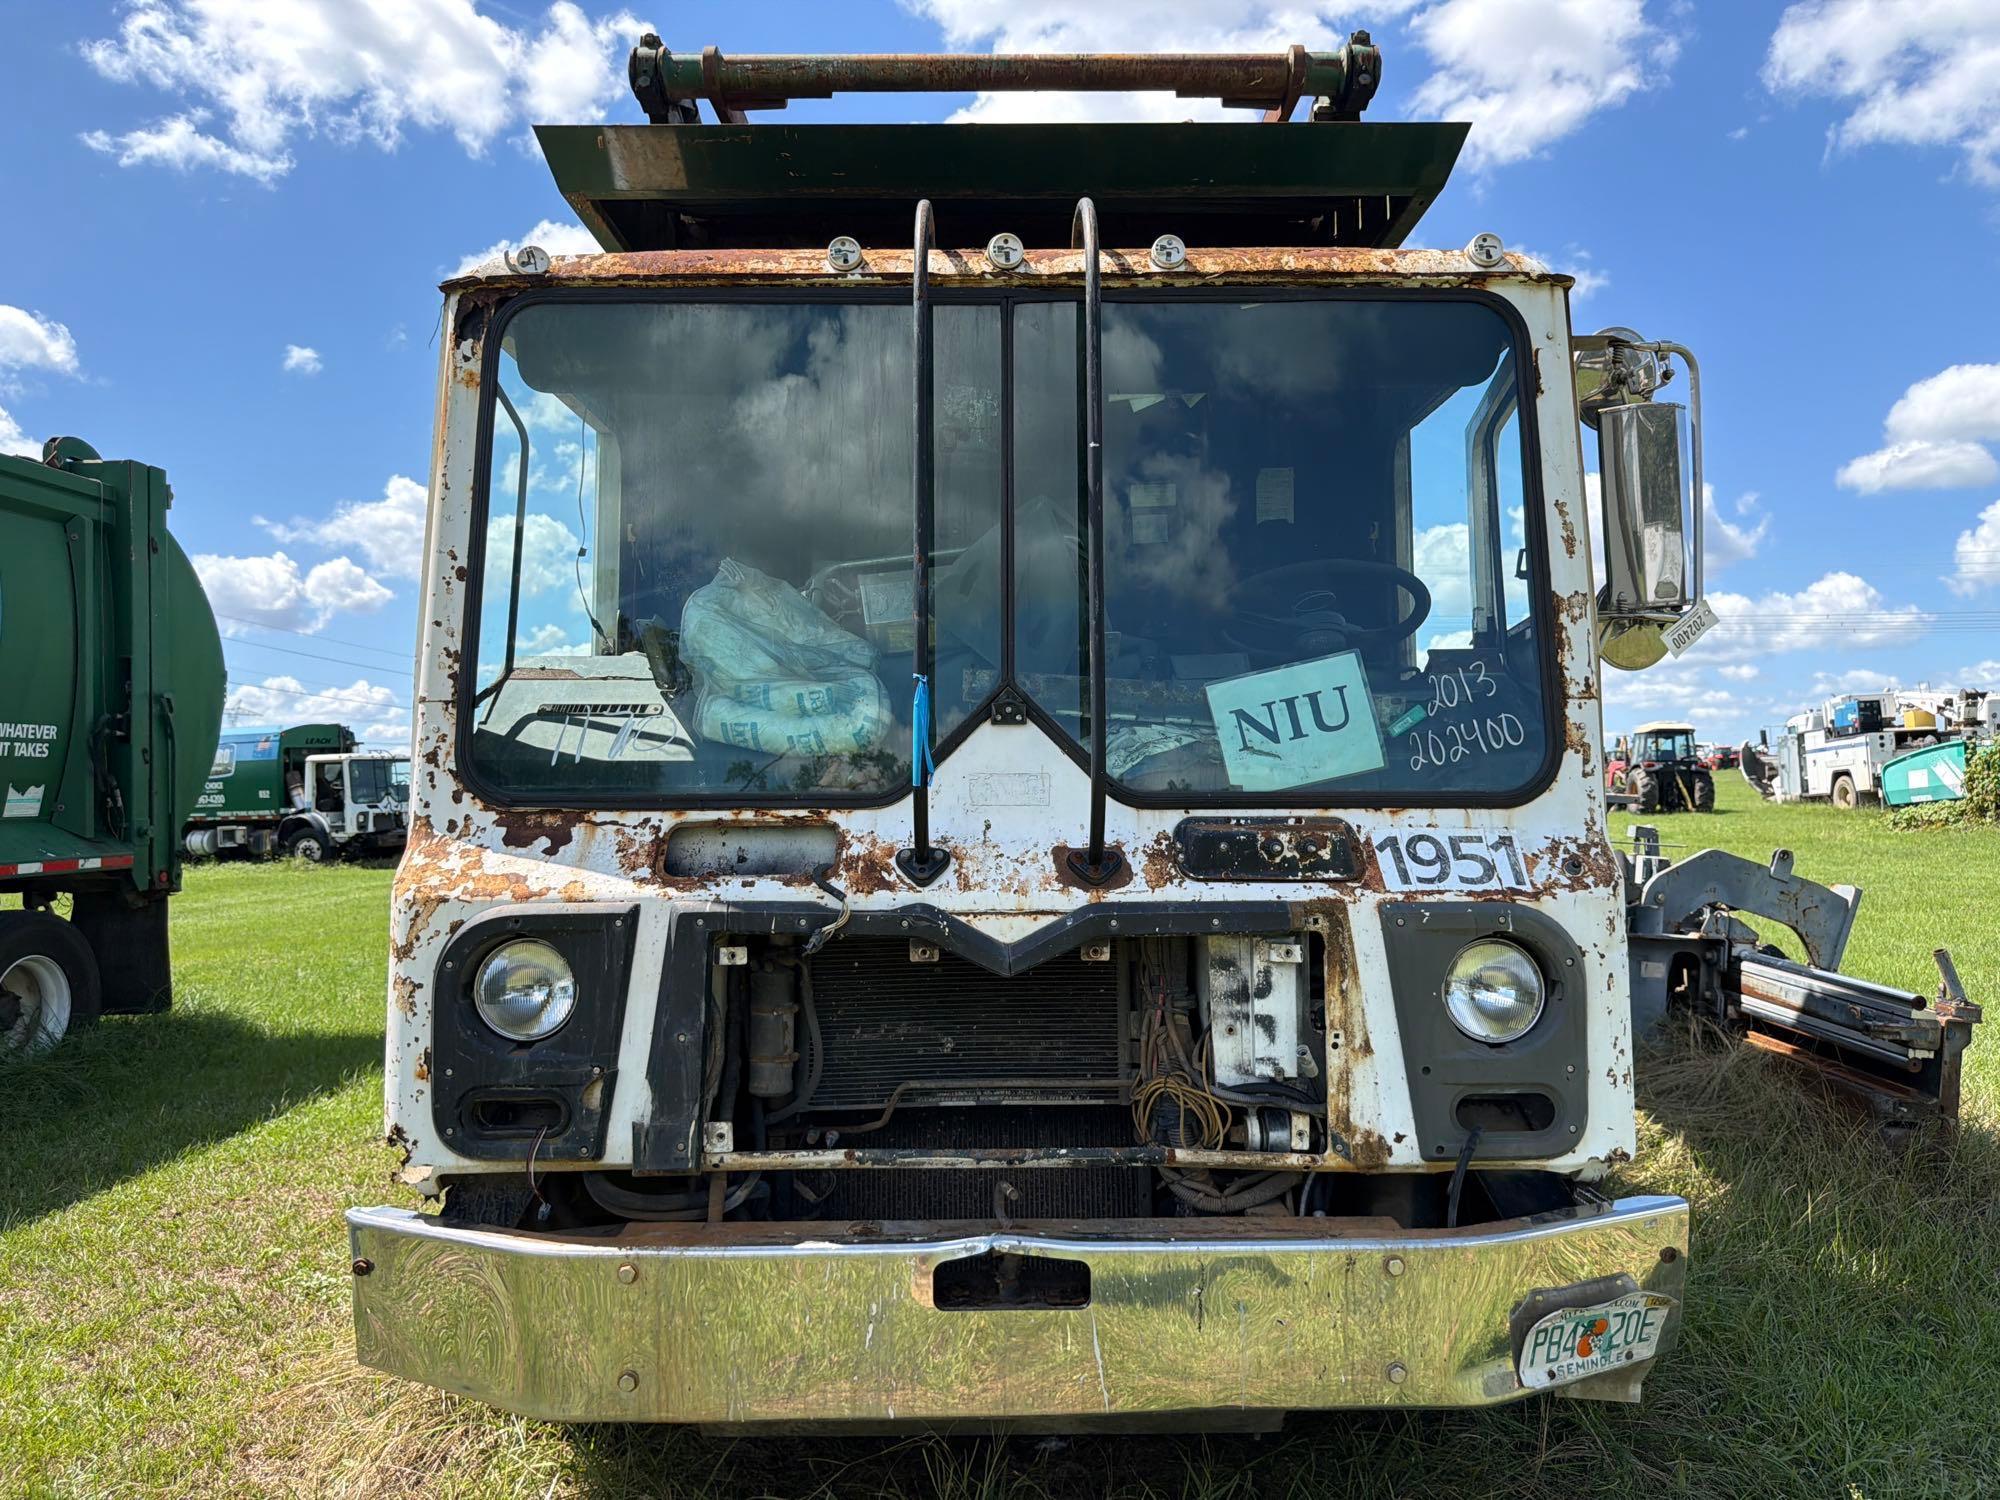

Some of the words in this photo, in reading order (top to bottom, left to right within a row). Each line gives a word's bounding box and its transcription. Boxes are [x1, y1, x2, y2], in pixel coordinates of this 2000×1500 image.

[1672, 615, 1706, 649] 202400
[1427, 661, 1497, 717] 2013
[1229, 685, 1350, 751] NIU
[1409, 713, 1525, 771] 202400
[14, 742, 49, 758] TAKES
[1374, 834, 1525, 886] 1951
[1556, 1351, 1624, 1376] SEMINOLE
